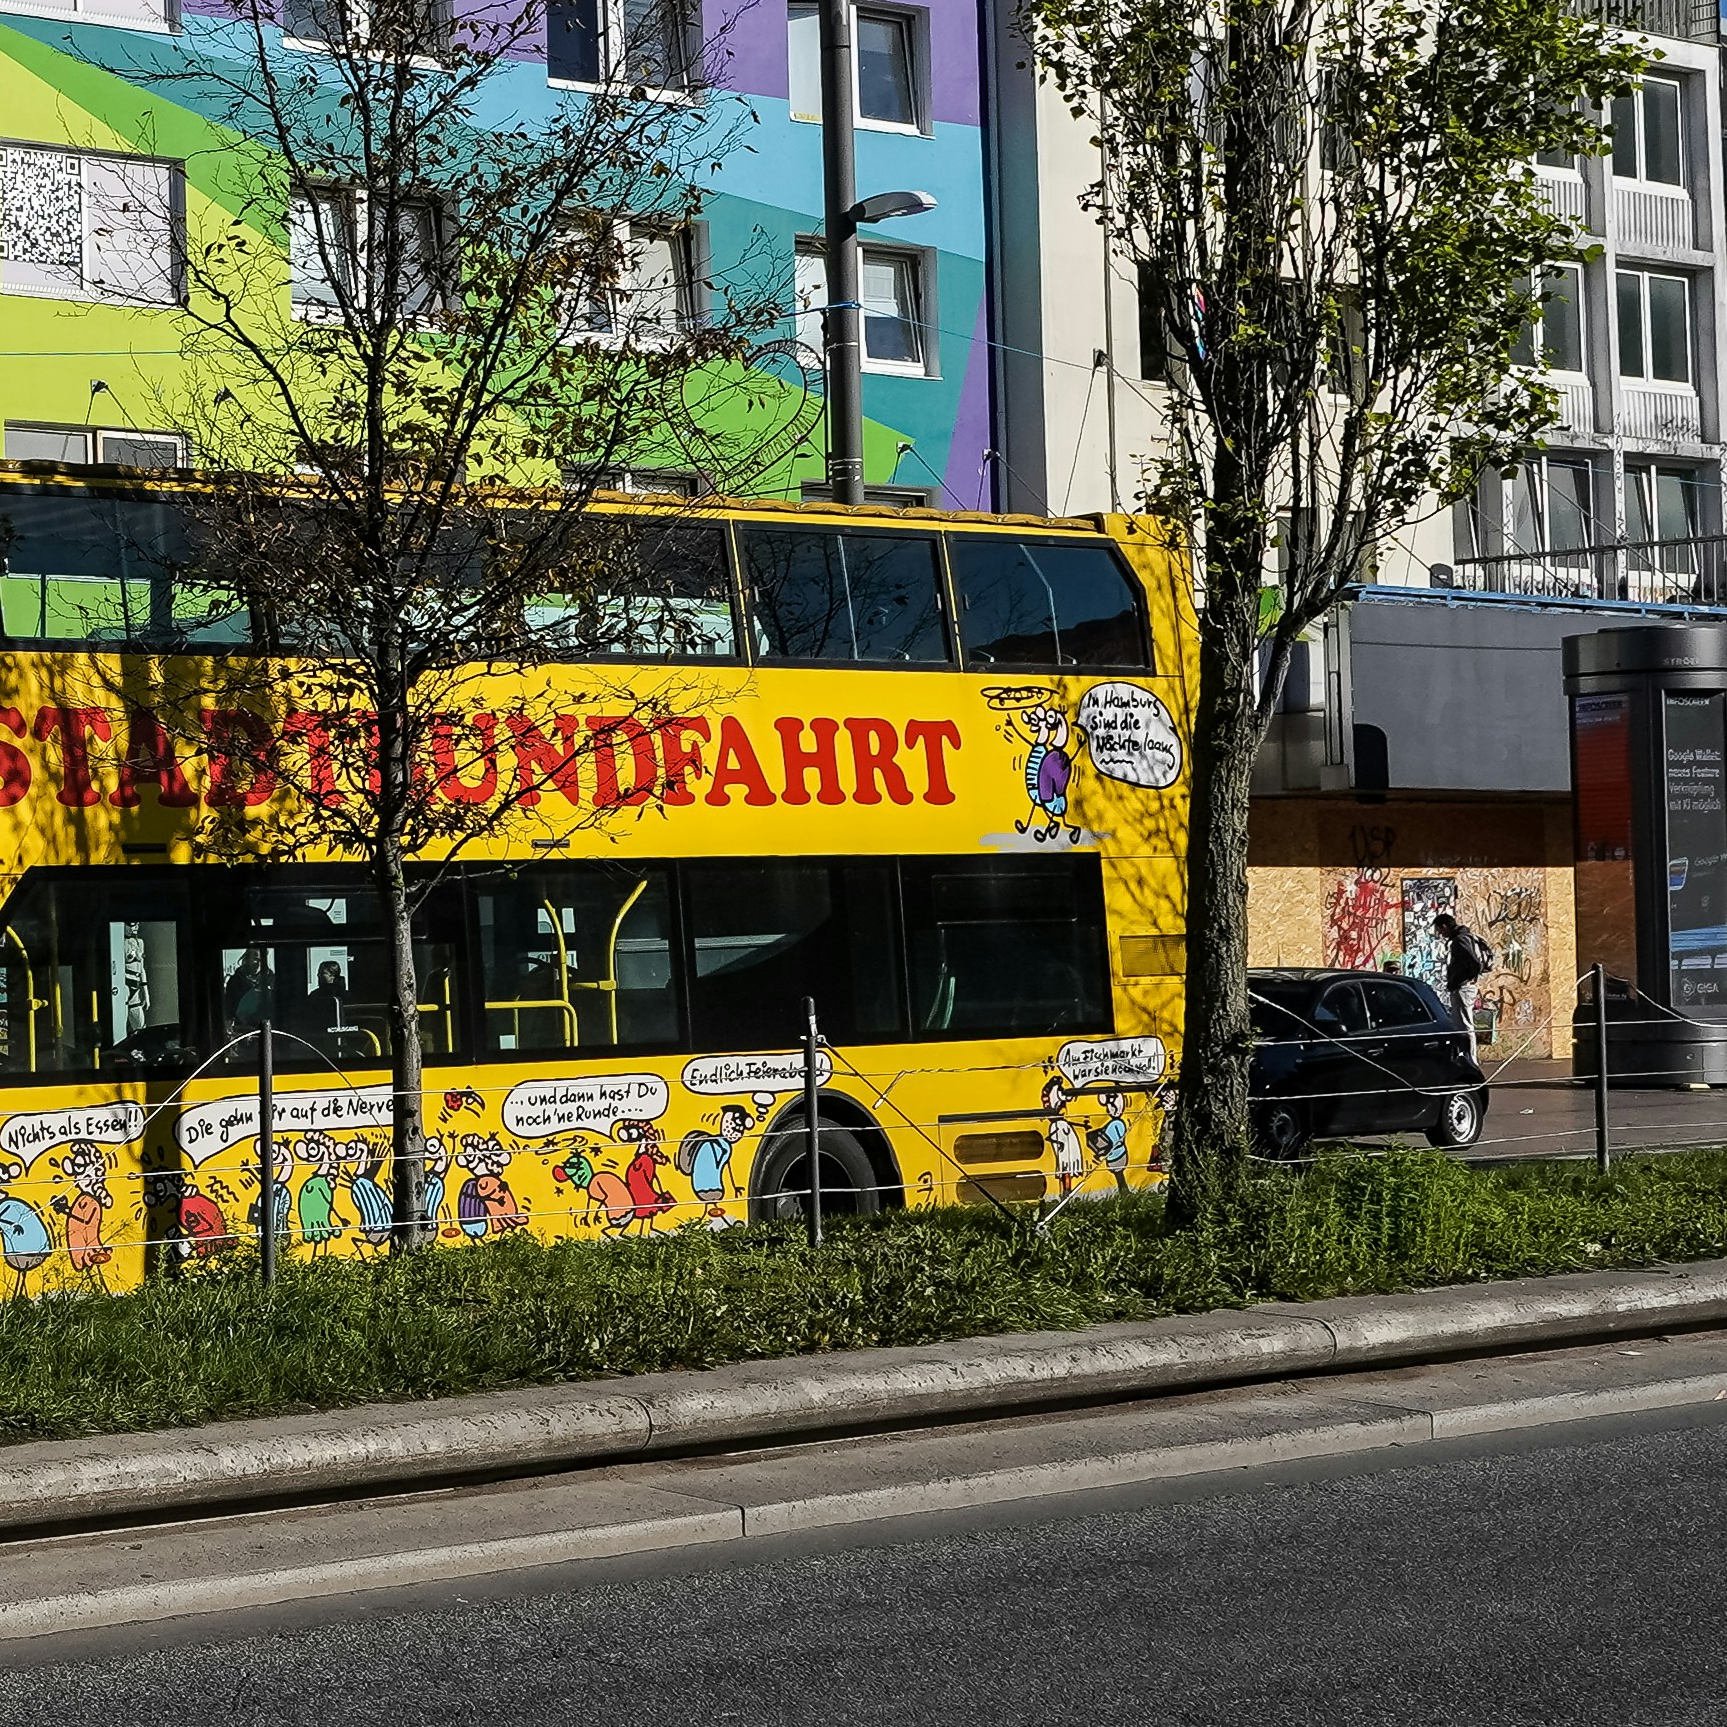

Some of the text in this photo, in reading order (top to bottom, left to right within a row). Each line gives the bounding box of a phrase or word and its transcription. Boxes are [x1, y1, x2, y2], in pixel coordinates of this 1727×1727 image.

[1103, 689, 1161, 718] Hamburg
[1119, 712, 1141, 731] die
[559, 1086, 594, 1104] dann
[599, 1083, 632, 1102] hast
[637, 1083, 658, 1099] Du
[59, 1114, 81, 1137] als
[185, 1118, 214, 1145] Die
[290, 1100, 318, 1125] auf
[321, 1097, 344, 1118] die
